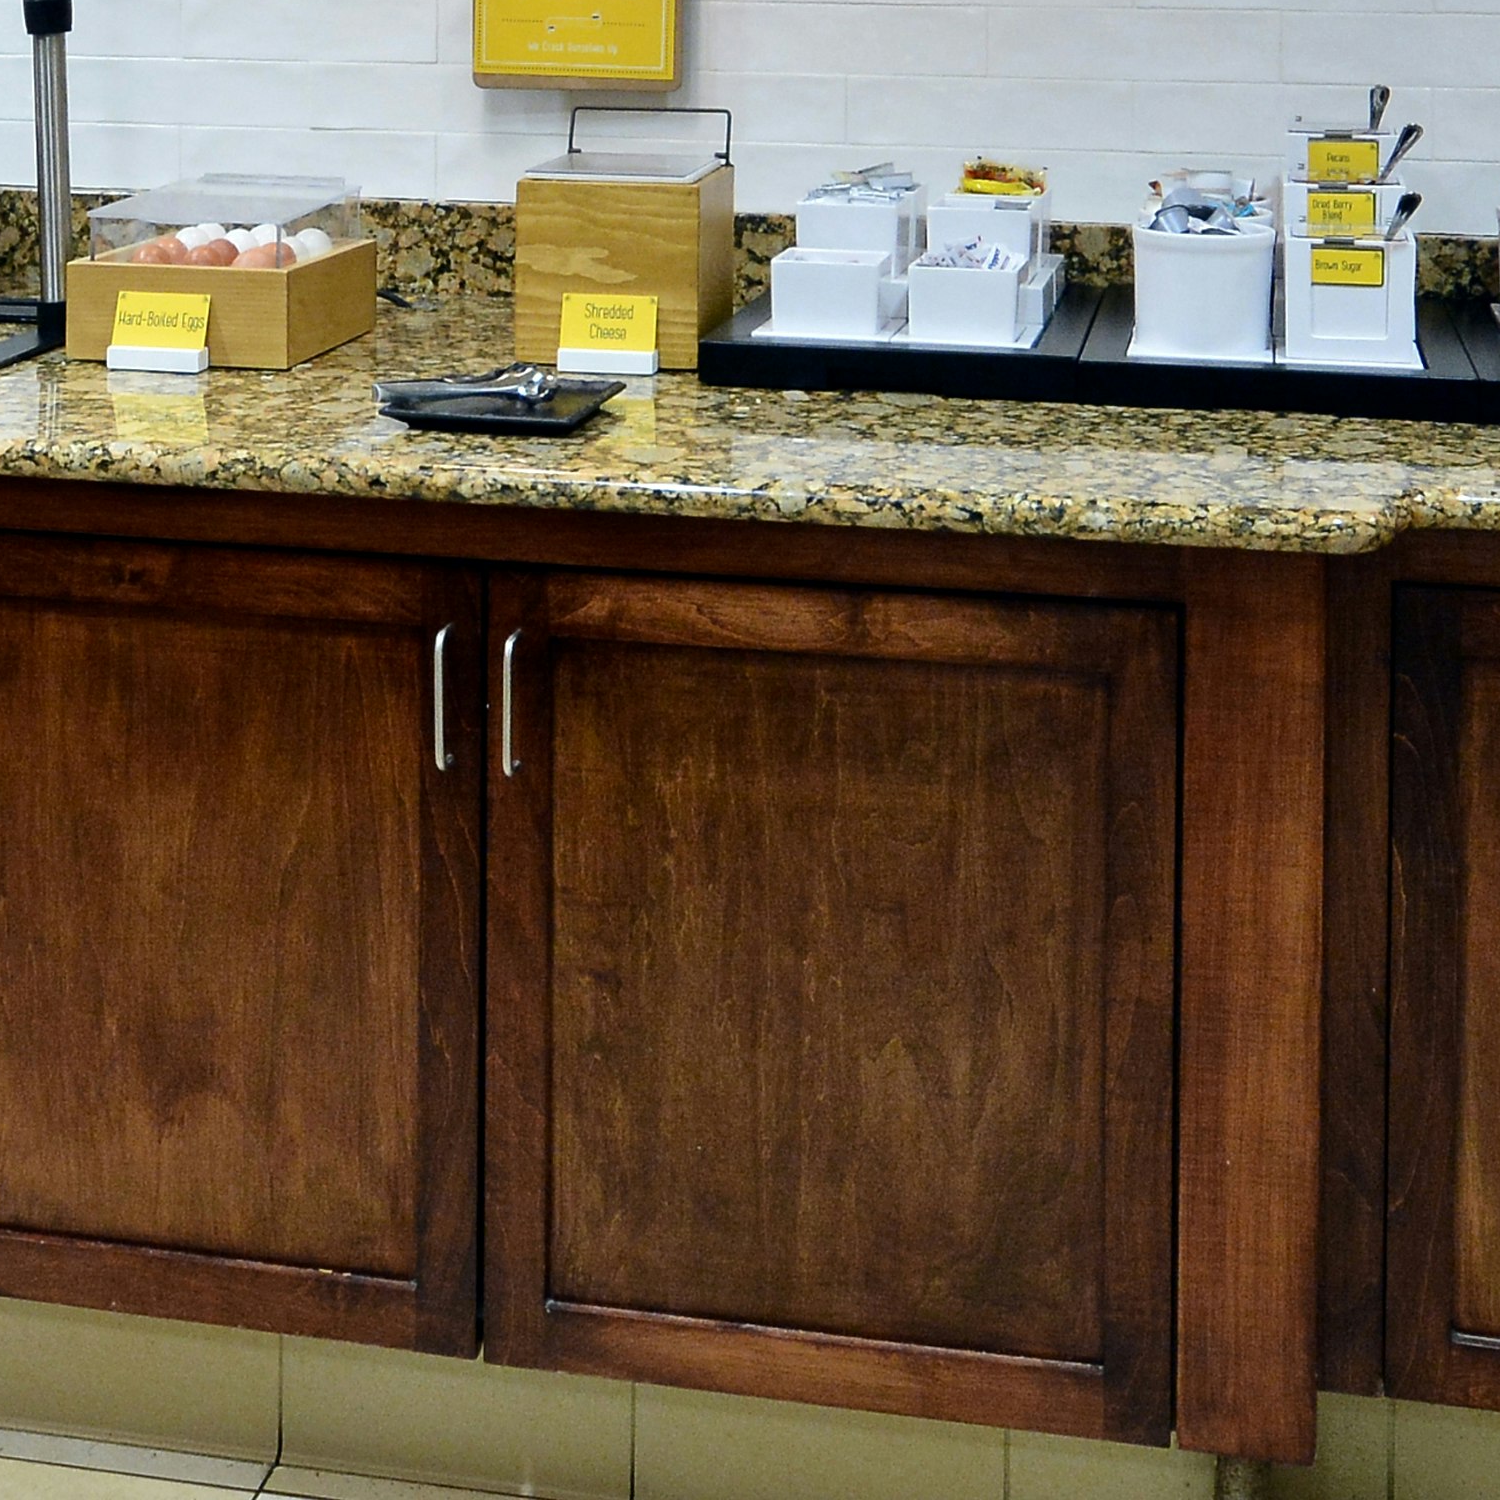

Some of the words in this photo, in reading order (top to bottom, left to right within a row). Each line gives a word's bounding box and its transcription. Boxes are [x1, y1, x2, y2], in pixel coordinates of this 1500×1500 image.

[1315, 259, 1339, 271] Brown
[1341, 260, 1363, 273] Sugar
[584, 302, 635, 320] Shredded
[118, 310, 179, 328] Hard-Boiled
[182, 312, 205, 332] Eggs
[589, 323, 627, 340] Cheese
